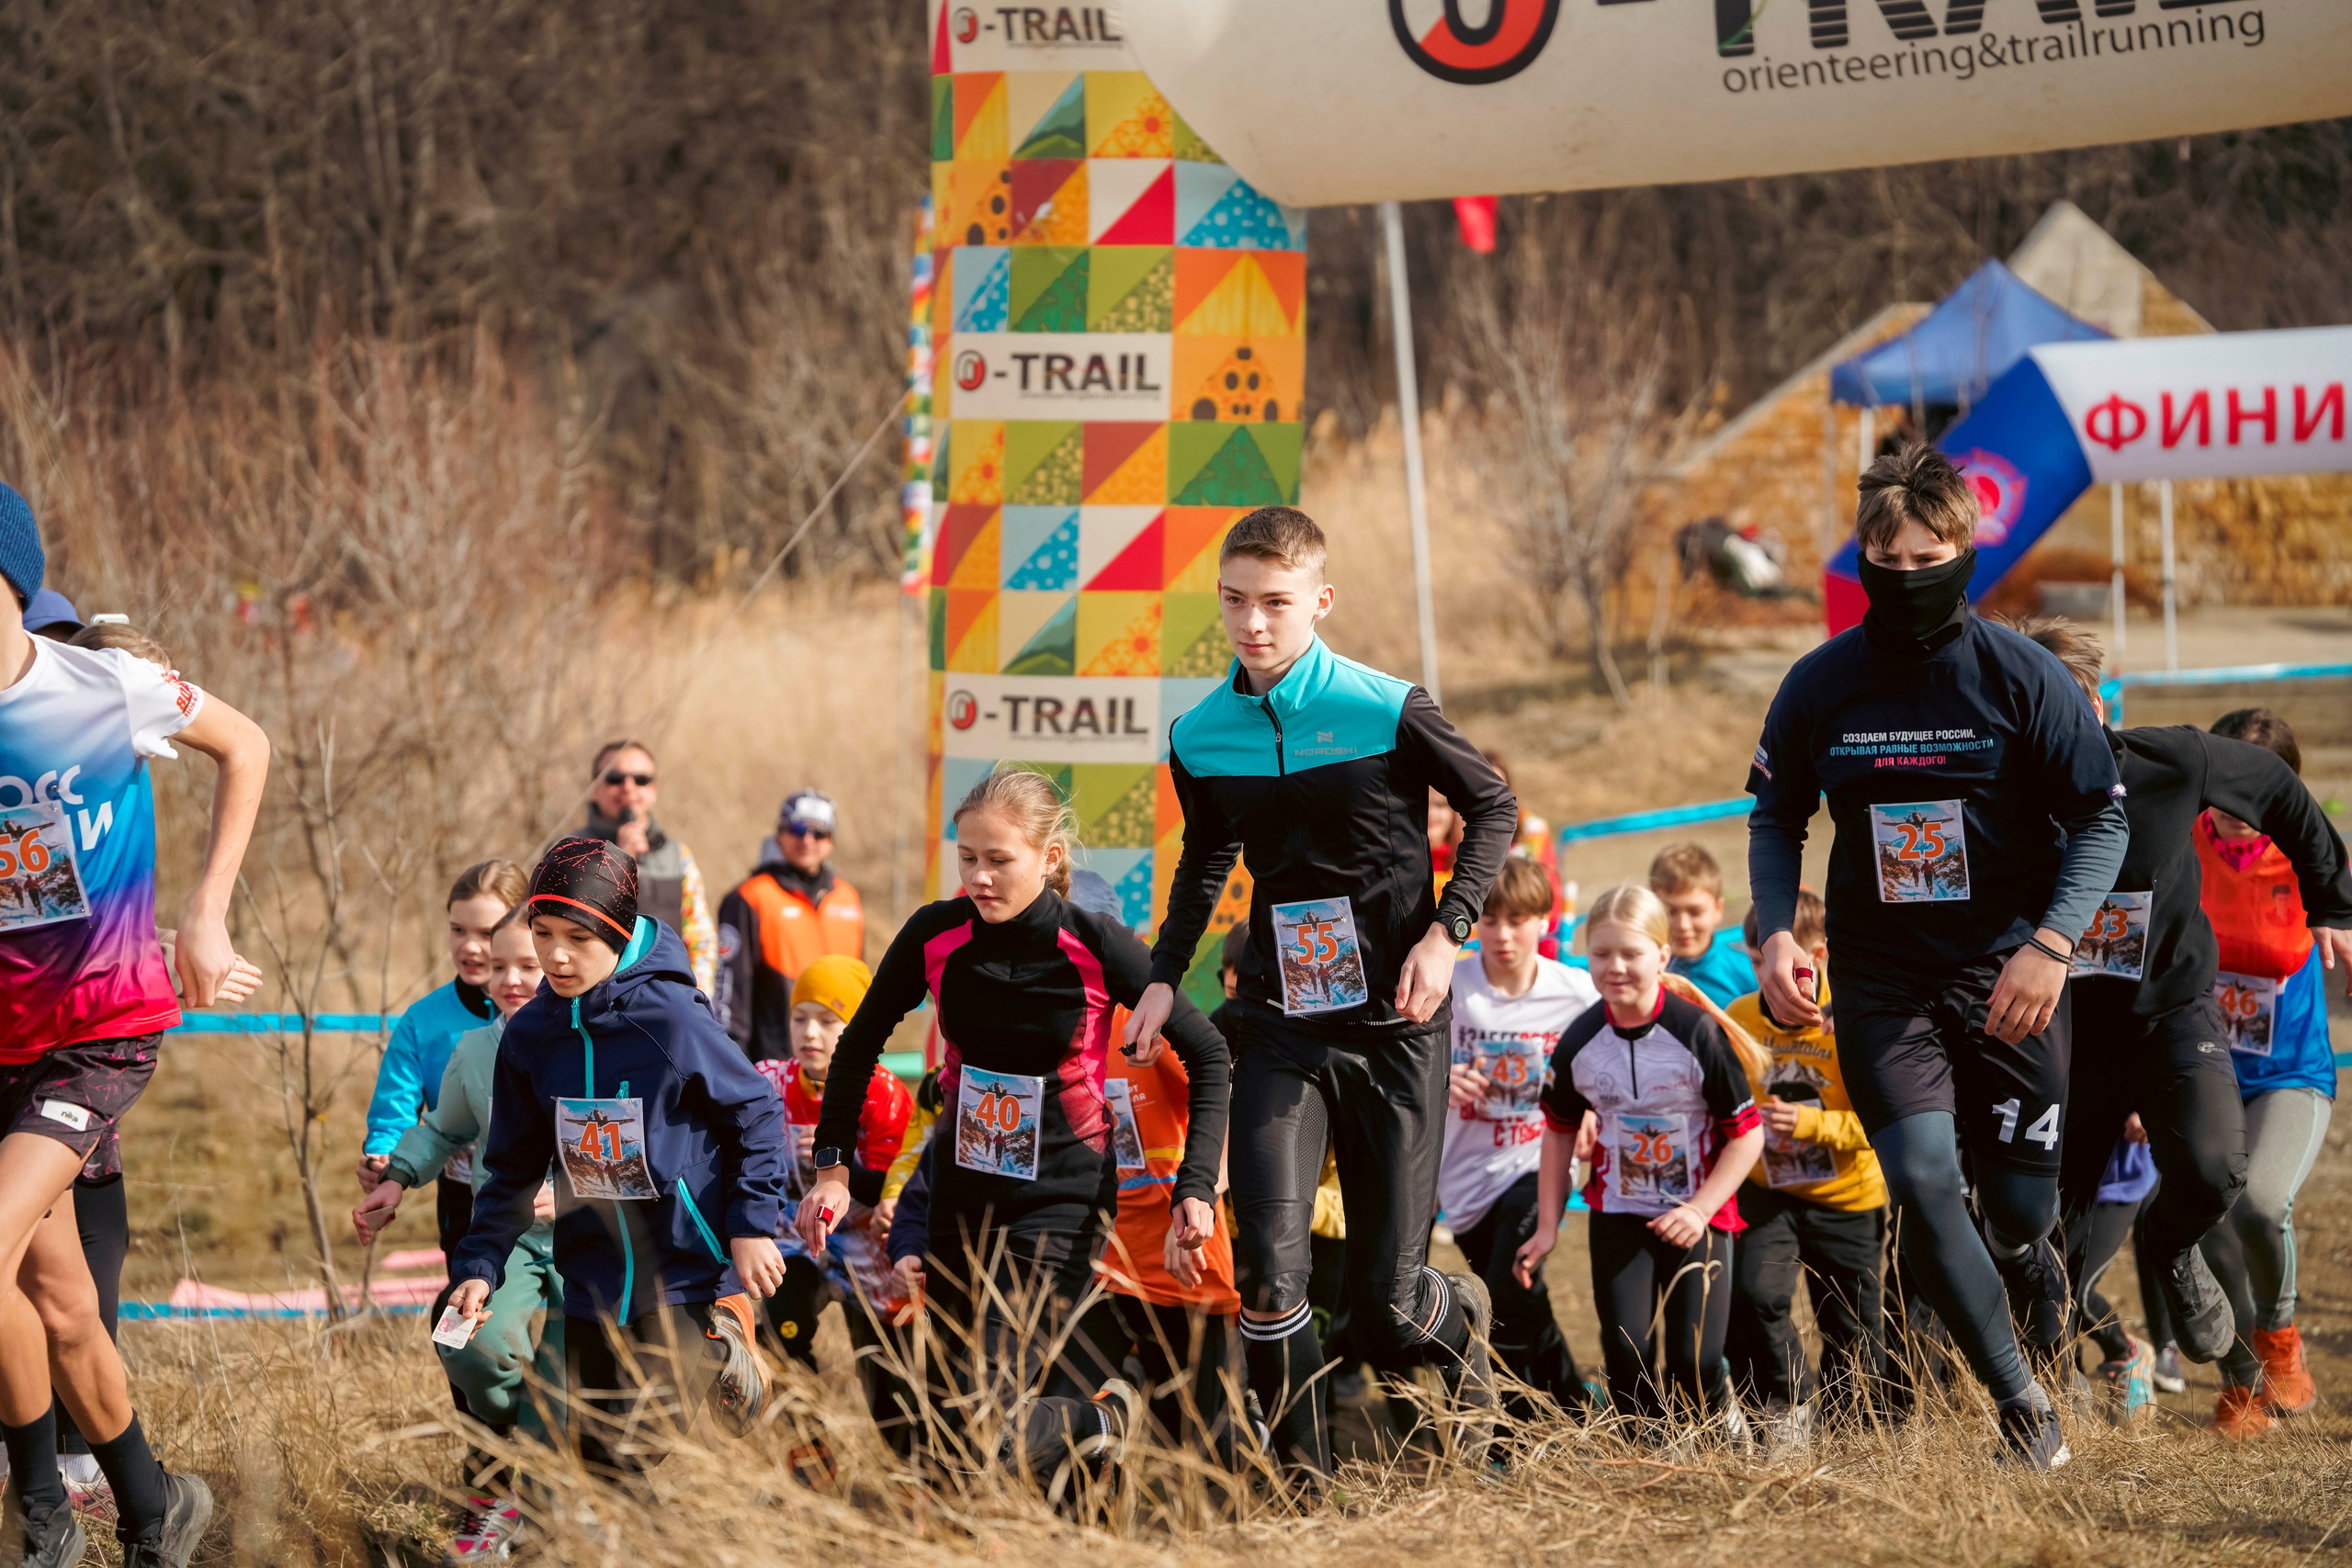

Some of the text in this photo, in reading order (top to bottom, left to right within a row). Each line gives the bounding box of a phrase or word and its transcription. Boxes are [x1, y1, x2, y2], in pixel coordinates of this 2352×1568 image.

[1723, 8, 2266, 94] orienteering&trailrunning
[2084, 382, 2346, 452] ФИНИ
[1294, 746, 1358, 758] NORDSKI
[1829, 739, 1994, 756] ОТКРЫВАЯ РАВНЫЕ ВОЗМОЖНОСТИ
[1842, 728, 1976, 744] СОЗДАЕМ БУДУЩЕЕ РОССИИ,
[1873, 755, 1947, 769] ДЛЯ КАЖДОГО!
[0, 829, 50, 879] 56
[1896, 822, 1945, 860] 25
[2083, 908, 2129, 938] 33
[1297, 922, 1338, 964] 55
[2219, 986, 2259, 1017] 46
[1492, 1055, 1528, 1084] 43
[975, 1092, 1021, 1132] 40
[1992, 1098, 2060, 1150] 14
[579, 1122, 623, 1161] 41
[1632, 1133, 1673, 1164] 26
